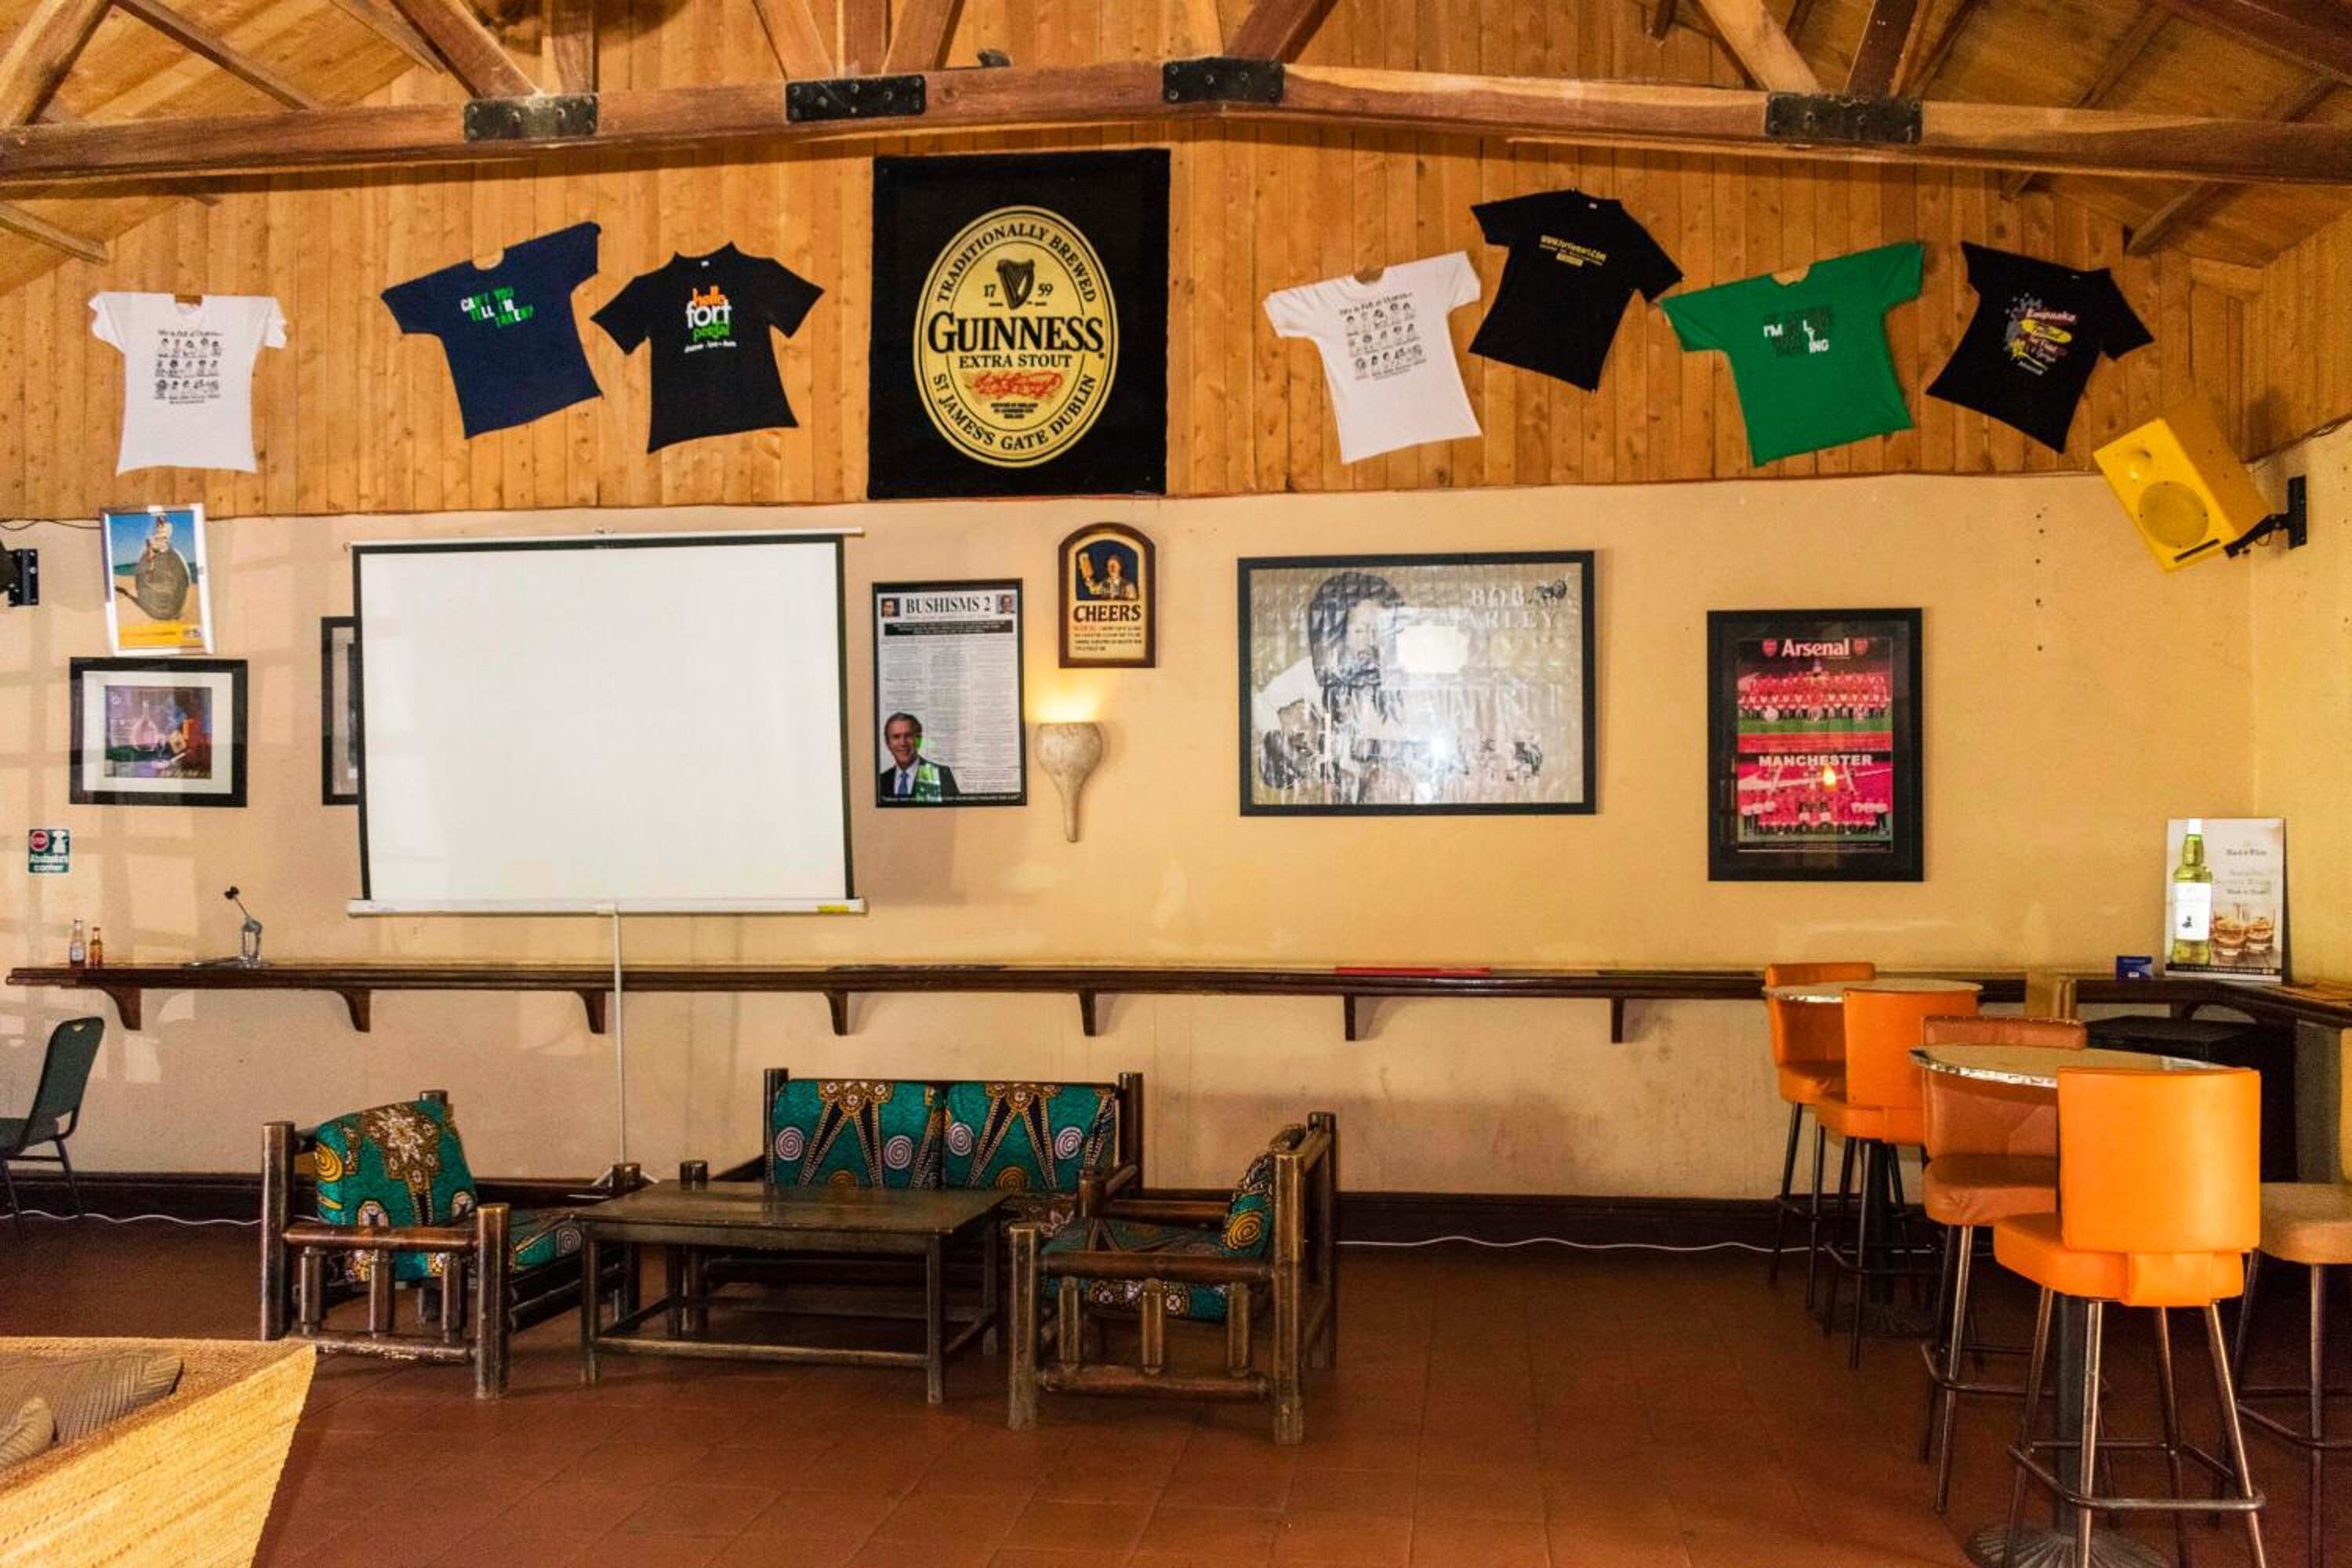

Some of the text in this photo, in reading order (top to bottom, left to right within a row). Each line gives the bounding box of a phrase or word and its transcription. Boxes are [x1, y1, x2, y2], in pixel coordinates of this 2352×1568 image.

[937, 222, 1097, 303] TRADITIONALLY BREWED
[984, 282, 1054, 298] 17 59
[685, 301, 732, 328] fort
[927, 310, 1105, 354] GUINNESS
[959, 354, 1073, 369] EXTRA STOUT
[1000, 430, 1049, 451] GATE
[1049, 374, 1096, 436] DUBLIN
[906, 596, 991, 614] BUSHISMS 2
[1470, 588, 1526, 608] BOB
[1073, 604, 1142, 623] CHEERS
[1444, 608, 1556, 629] ARLEY
[1780, 637, 1849, 658] Arsenal
[1759, 753, 1873, 767] MANCHESTER
